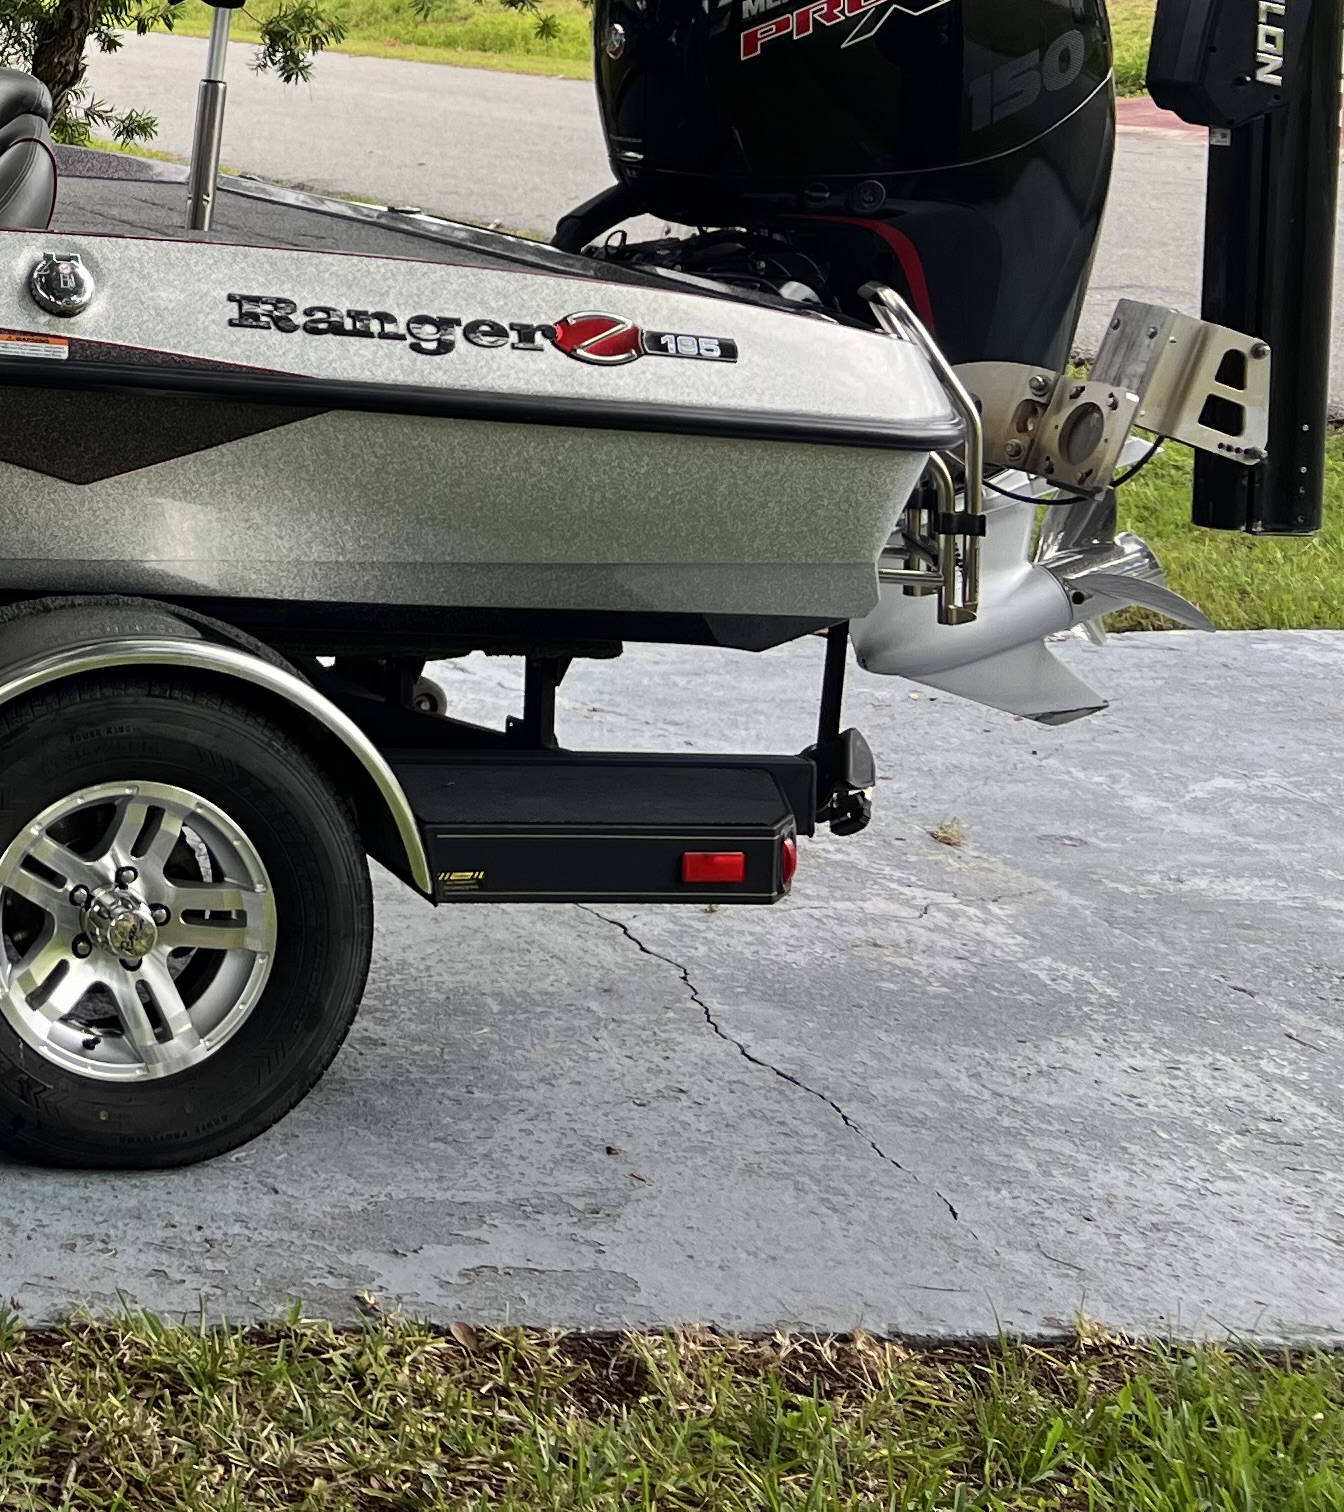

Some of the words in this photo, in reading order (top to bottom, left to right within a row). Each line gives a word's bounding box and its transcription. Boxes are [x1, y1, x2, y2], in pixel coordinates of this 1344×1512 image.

[968, 29, 1085, 131] 150
[226, 292, 560, 356] Ranger
[659, 334, 722, 358] 195
